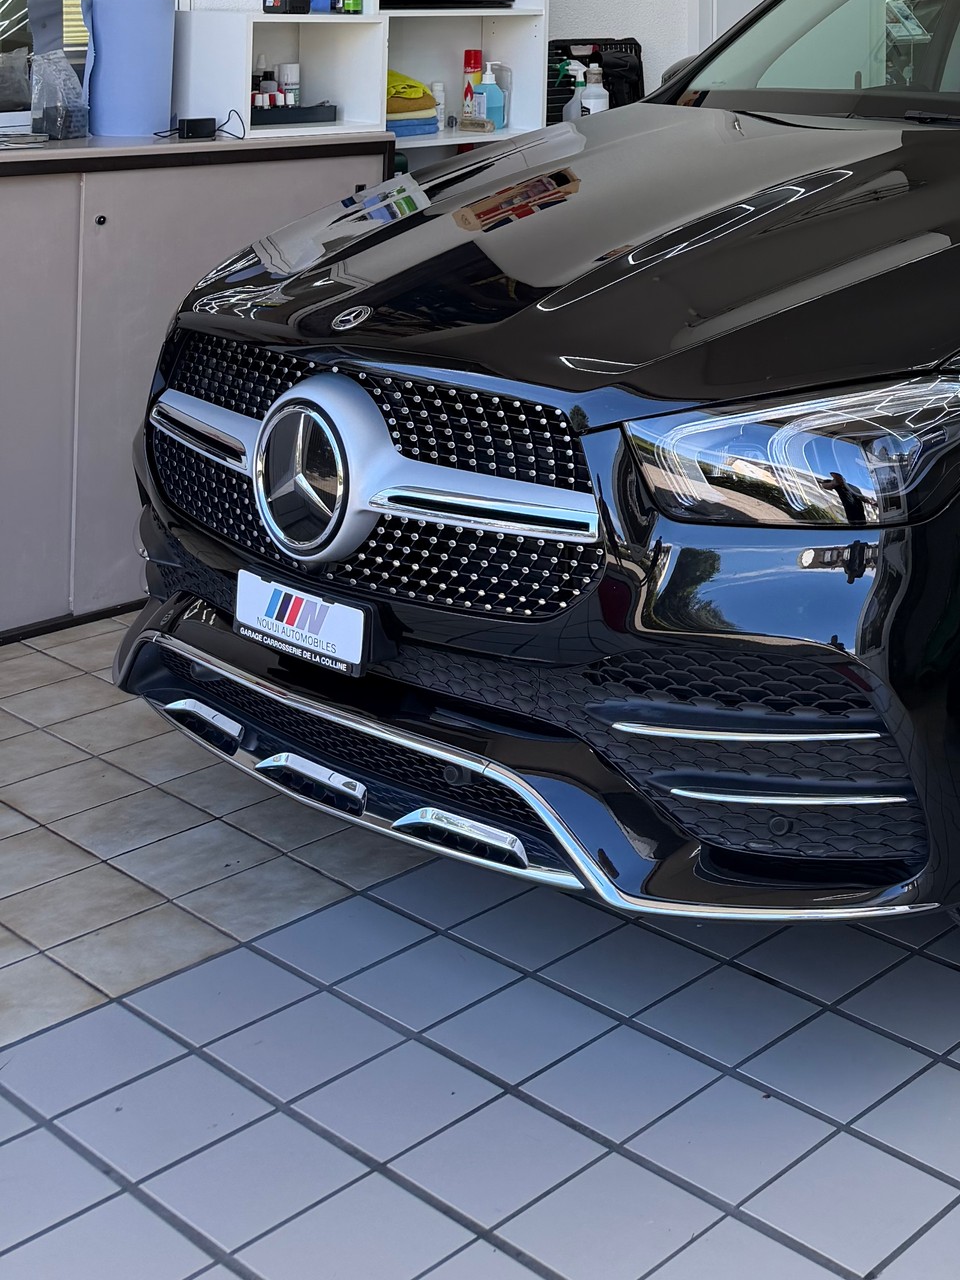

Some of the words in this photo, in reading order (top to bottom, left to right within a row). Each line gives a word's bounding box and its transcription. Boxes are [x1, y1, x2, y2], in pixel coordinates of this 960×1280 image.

[240, 626, 263, 642] GARAGE
[263, 635, 302, 656] CARROSSERIE
[303, 650, 311, 660] DE
[312, 653, 320, 663] LA
[321, 656, 347, 672] COLLINE
[281, 626, 337, 654] AUTOMOBILES
